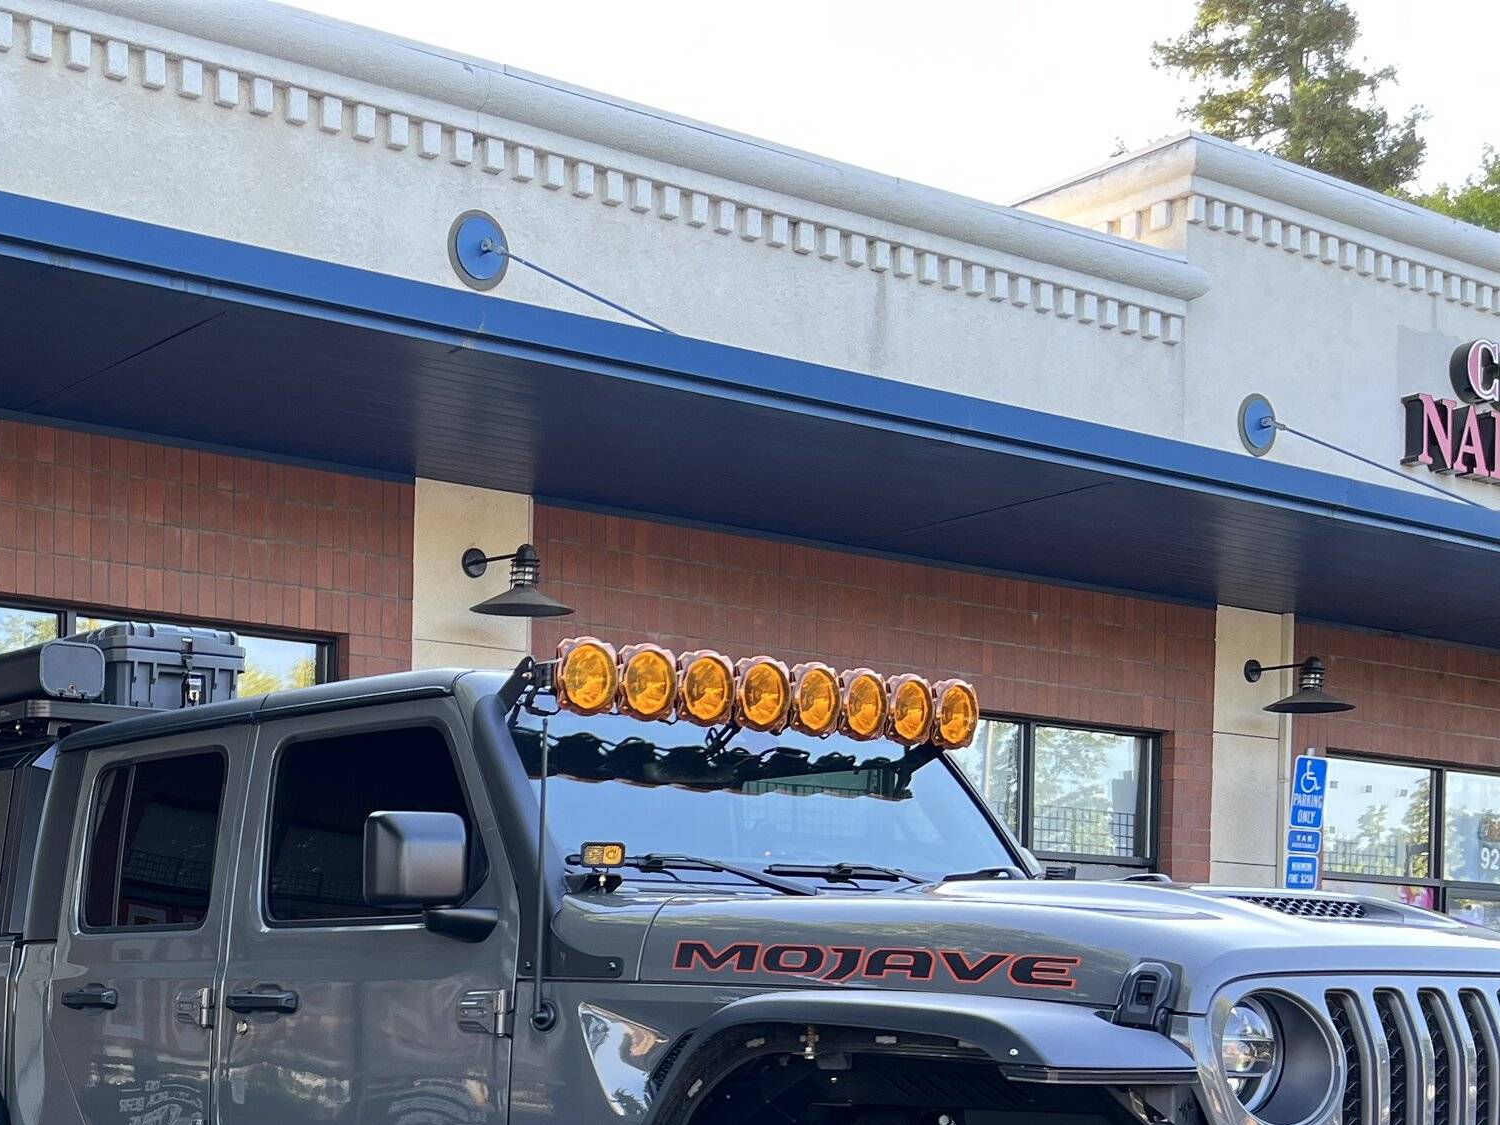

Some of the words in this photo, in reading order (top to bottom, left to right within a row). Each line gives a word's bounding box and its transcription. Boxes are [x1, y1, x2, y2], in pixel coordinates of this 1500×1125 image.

[1292, 793, 1323, 809] PARKING
[1296, 808, 1316, 825] ONLY
[672, 940, 1082, 990] MOJAVE
